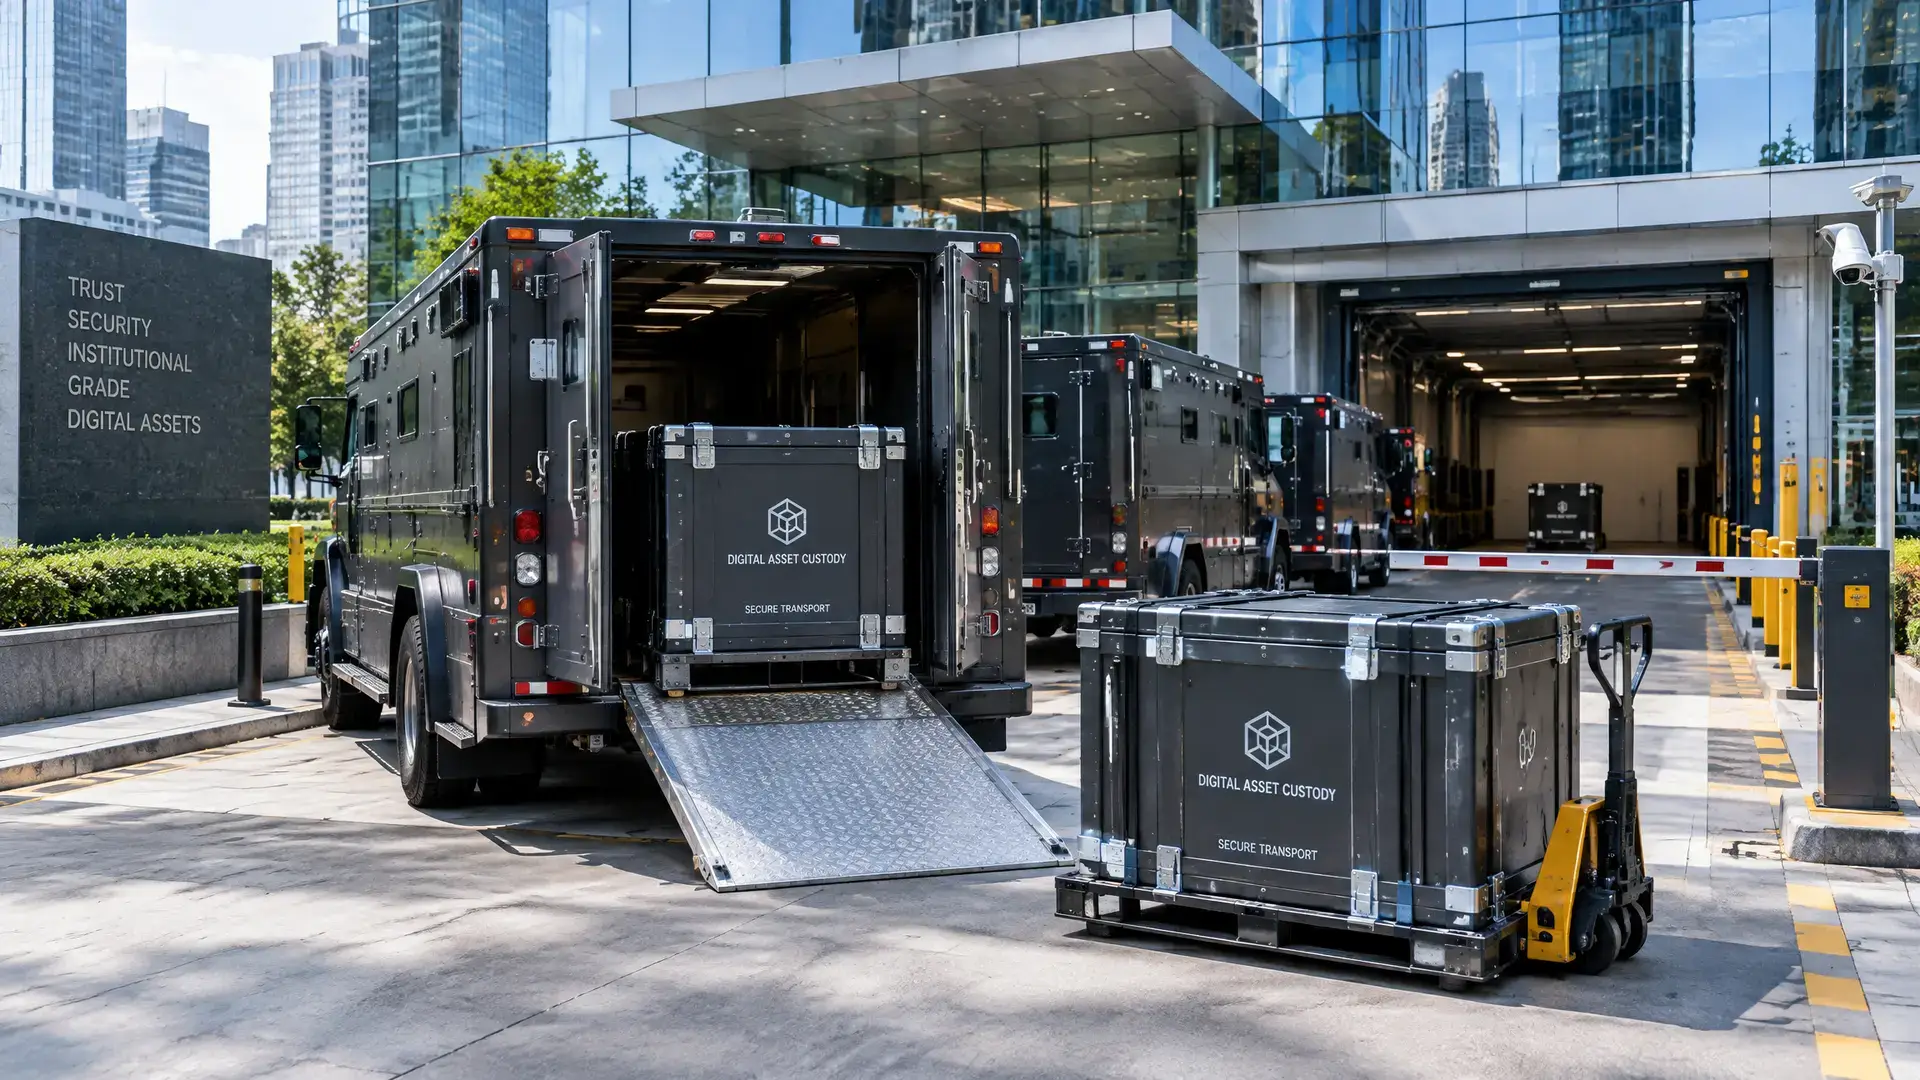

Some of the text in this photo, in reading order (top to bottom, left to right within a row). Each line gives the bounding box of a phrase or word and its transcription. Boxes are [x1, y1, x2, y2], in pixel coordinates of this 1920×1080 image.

[68, 276, 125, 303] TRUST
[68, 309, 152, 337] SECURITY
[68, 341, 193, 373] INSTITUTIONAL
[68, 374, 130, 399] GRADE
[68, 408, 202, 434] DIGITAL ASSETS
[727, 553, 847, 565] DIGITAL ASSET CUSTODY
[744, 603, 831, 614] SECURE TRANSPORT
[1198, 773, 1337, 802] DIGITAL ASSET CUSTODY
[1218, 838, 1318, 861] SECURE TRANSPORT
